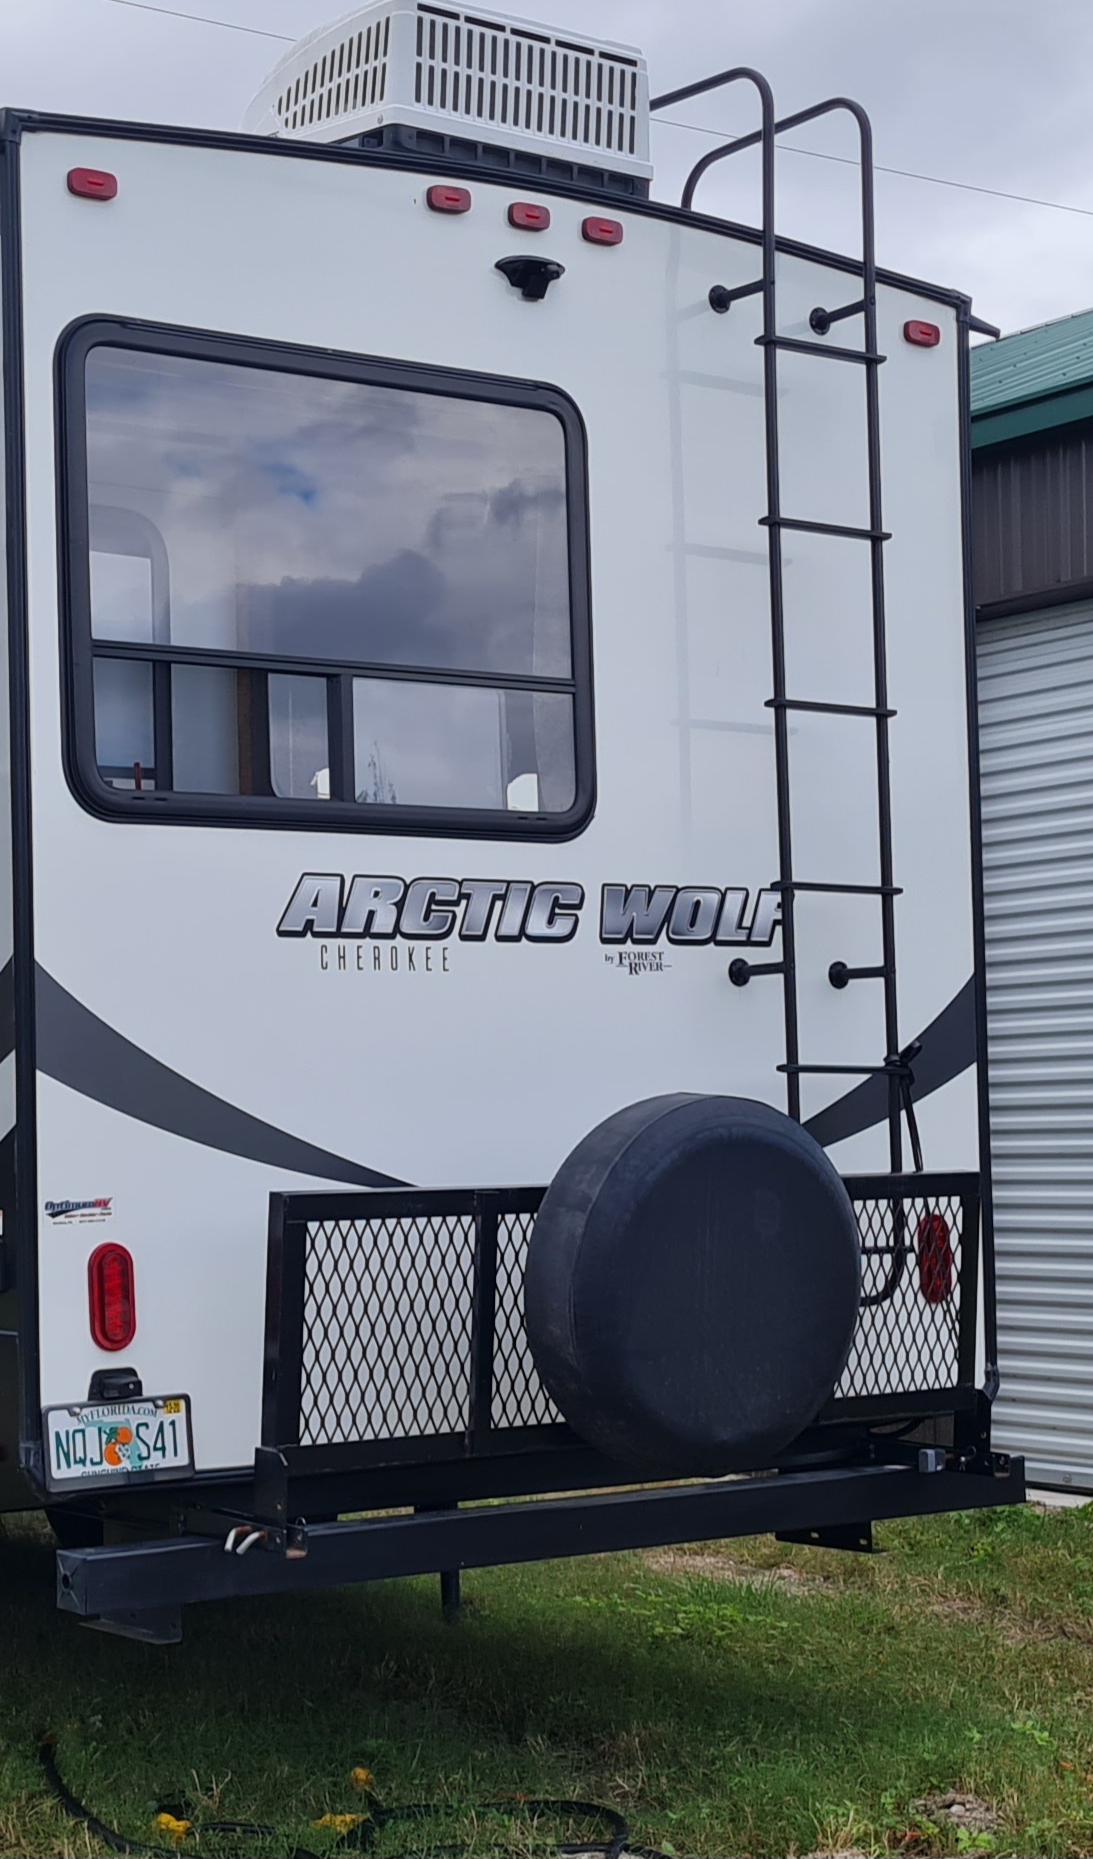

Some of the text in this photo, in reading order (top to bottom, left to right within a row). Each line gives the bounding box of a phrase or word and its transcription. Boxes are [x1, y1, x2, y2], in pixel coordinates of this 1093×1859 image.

[276, 872, 784, 947] ARCTIC WOLF
[319, 943, 450, 972] CHEROKEE
[617, 951, 665, 966] FOREST
[628, 961, 664, 975] RIVER
[54, 1419, 178, 1470] NQJ S41
